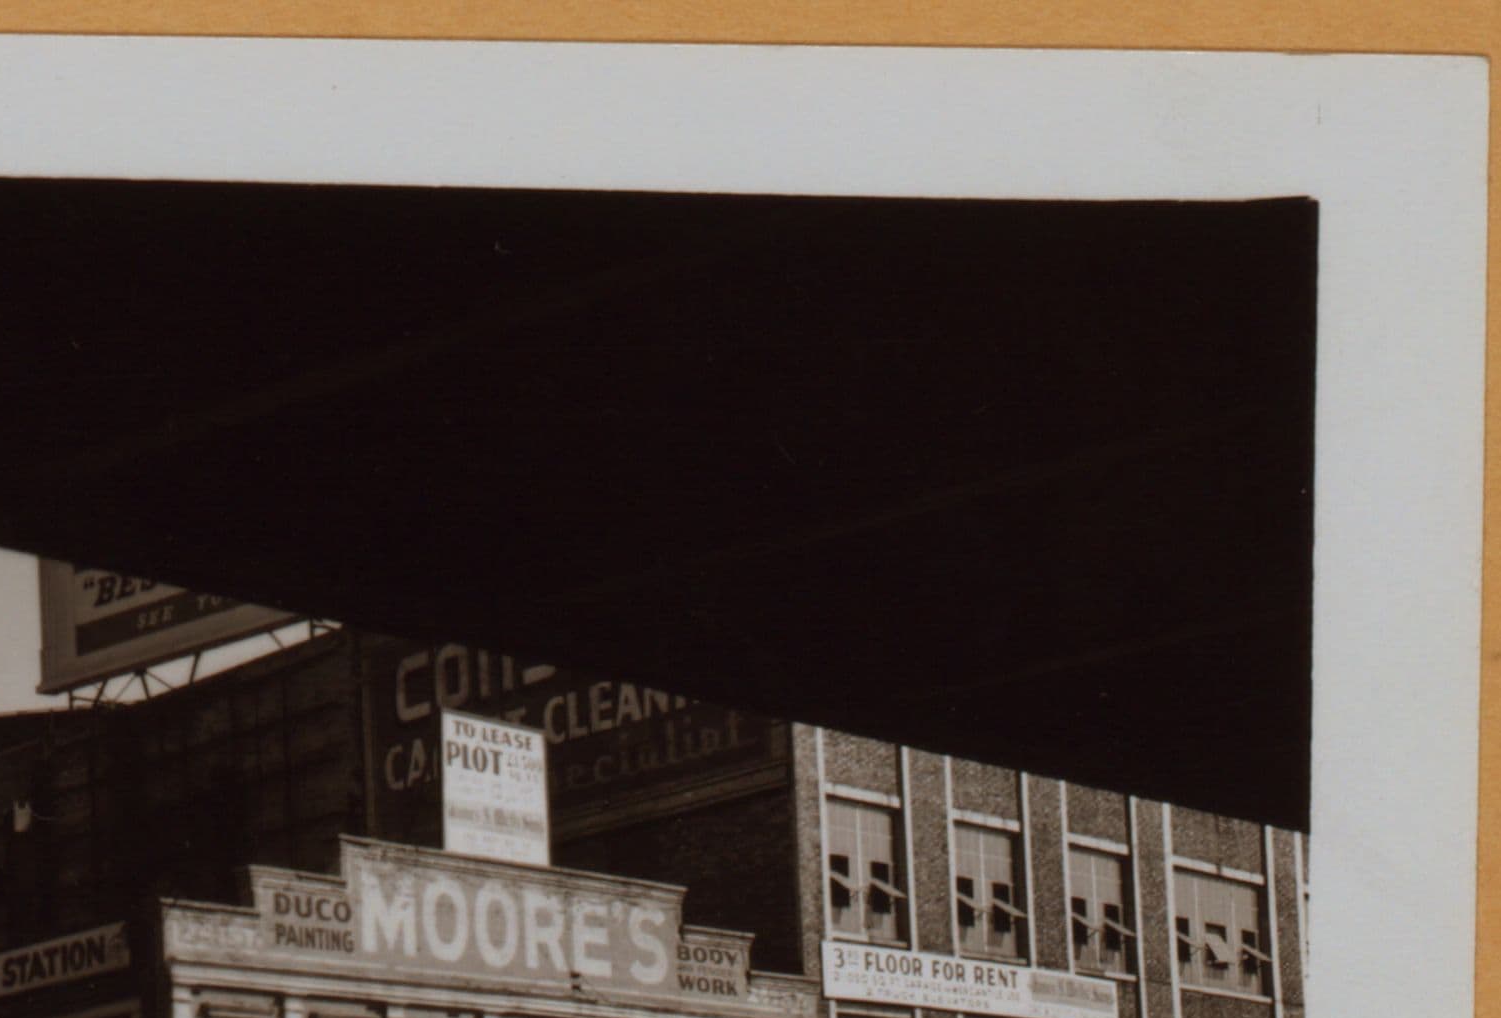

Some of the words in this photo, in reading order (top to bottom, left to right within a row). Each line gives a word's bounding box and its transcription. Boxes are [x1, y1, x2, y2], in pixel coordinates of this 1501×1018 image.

[453, 720, 475, 738] TO
[483, 728, 532, 751] LEASE
[446, 742, 502, 776] PLOT
[273, 892, 352, 922] DUCO
[275, 923, 355, 953] PAINTING
[360, 869, 669, 984] MOORE'S
[2, 934, 107, 987] STATION
[676, 944, 738, 966] BODY
[864, 951, 923, 977] FLOOR
[932, 960, 967, 983] FOR
[974, 966, 1018, 990] RENT
[677, 973, 738, 996] WORK
